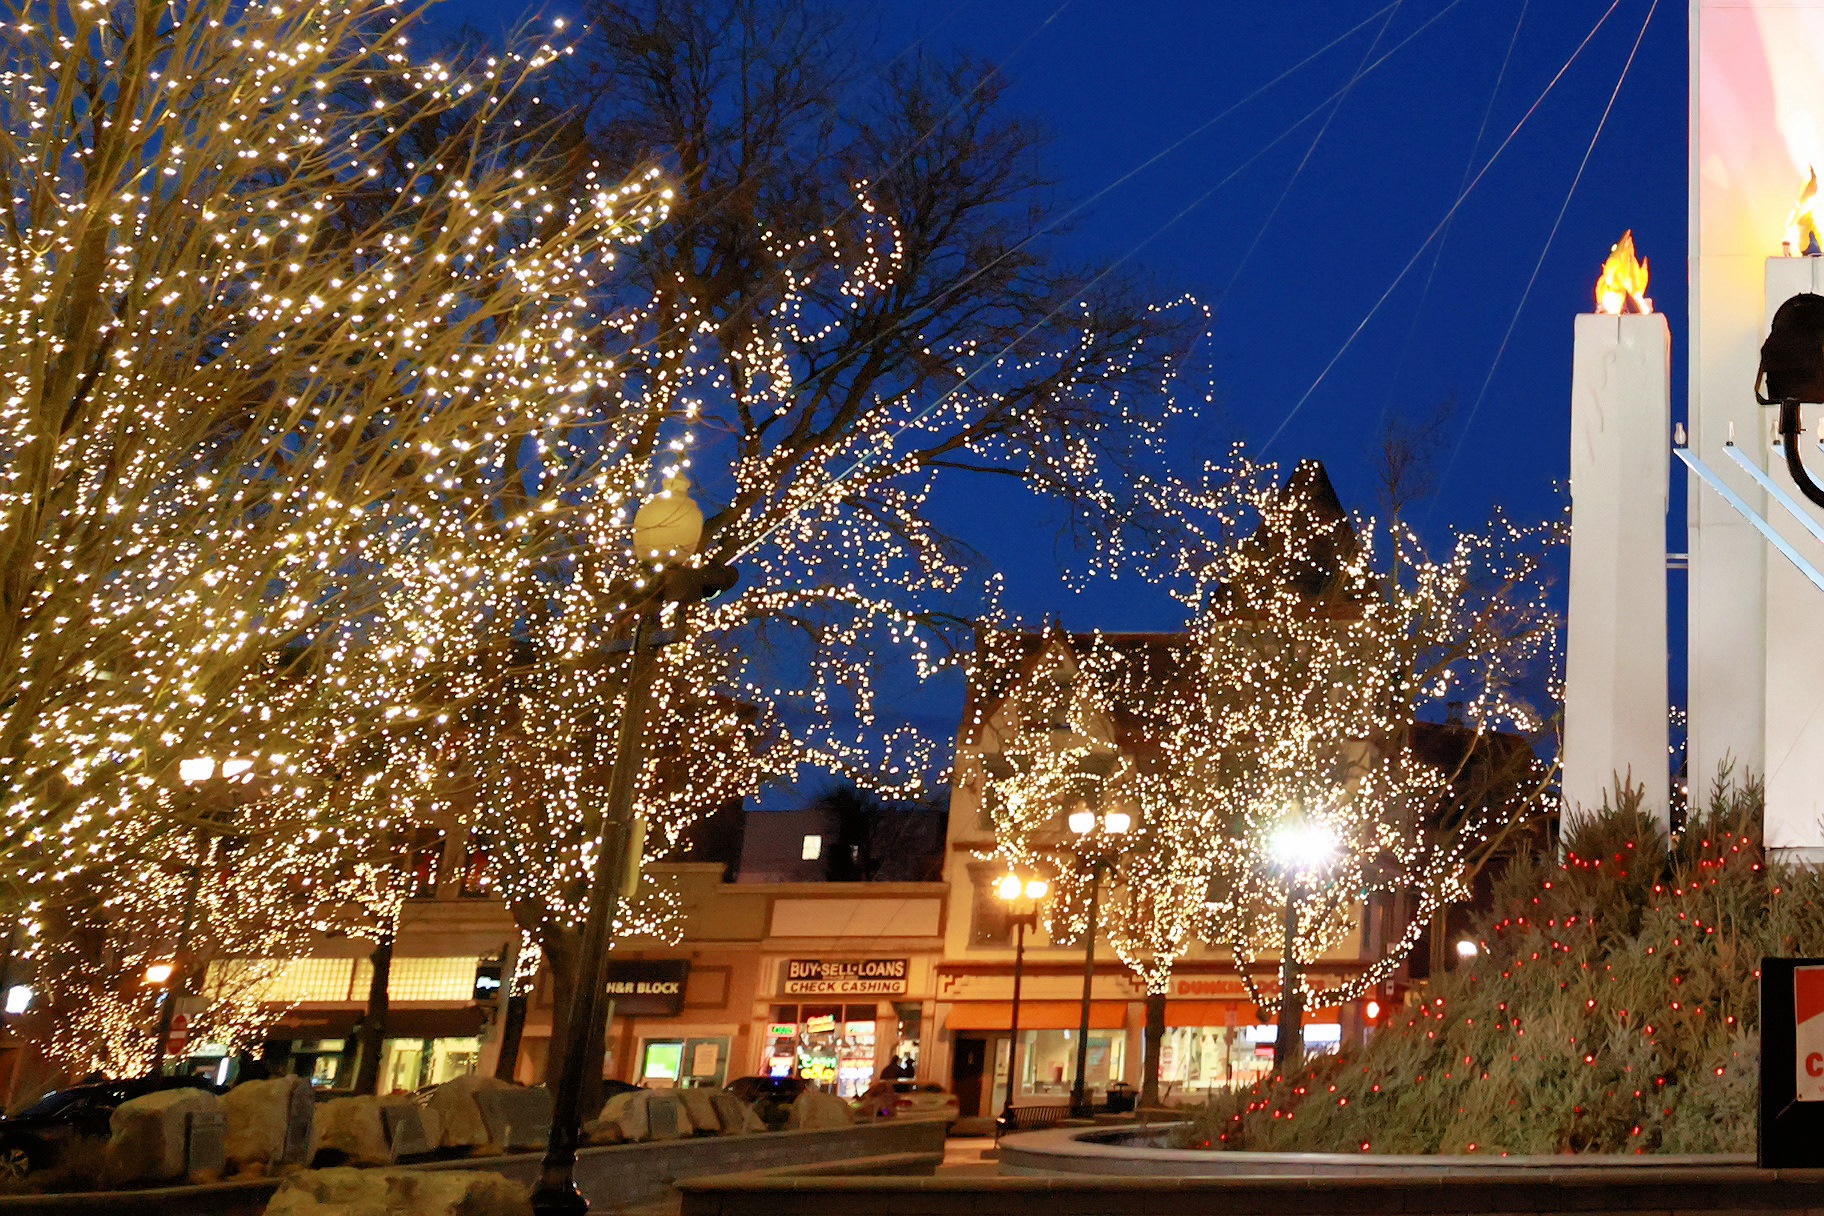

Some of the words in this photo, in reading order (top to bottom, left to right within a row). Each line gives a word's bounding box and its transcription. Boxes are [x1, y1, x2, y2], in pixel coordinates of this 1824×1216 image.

[606, 981, 634, 994] H&R
[637, 981, 679, 994] BLOCK
[790, 982, 836, 993] CHECK
[840, 981, 901, 992] CASHING
